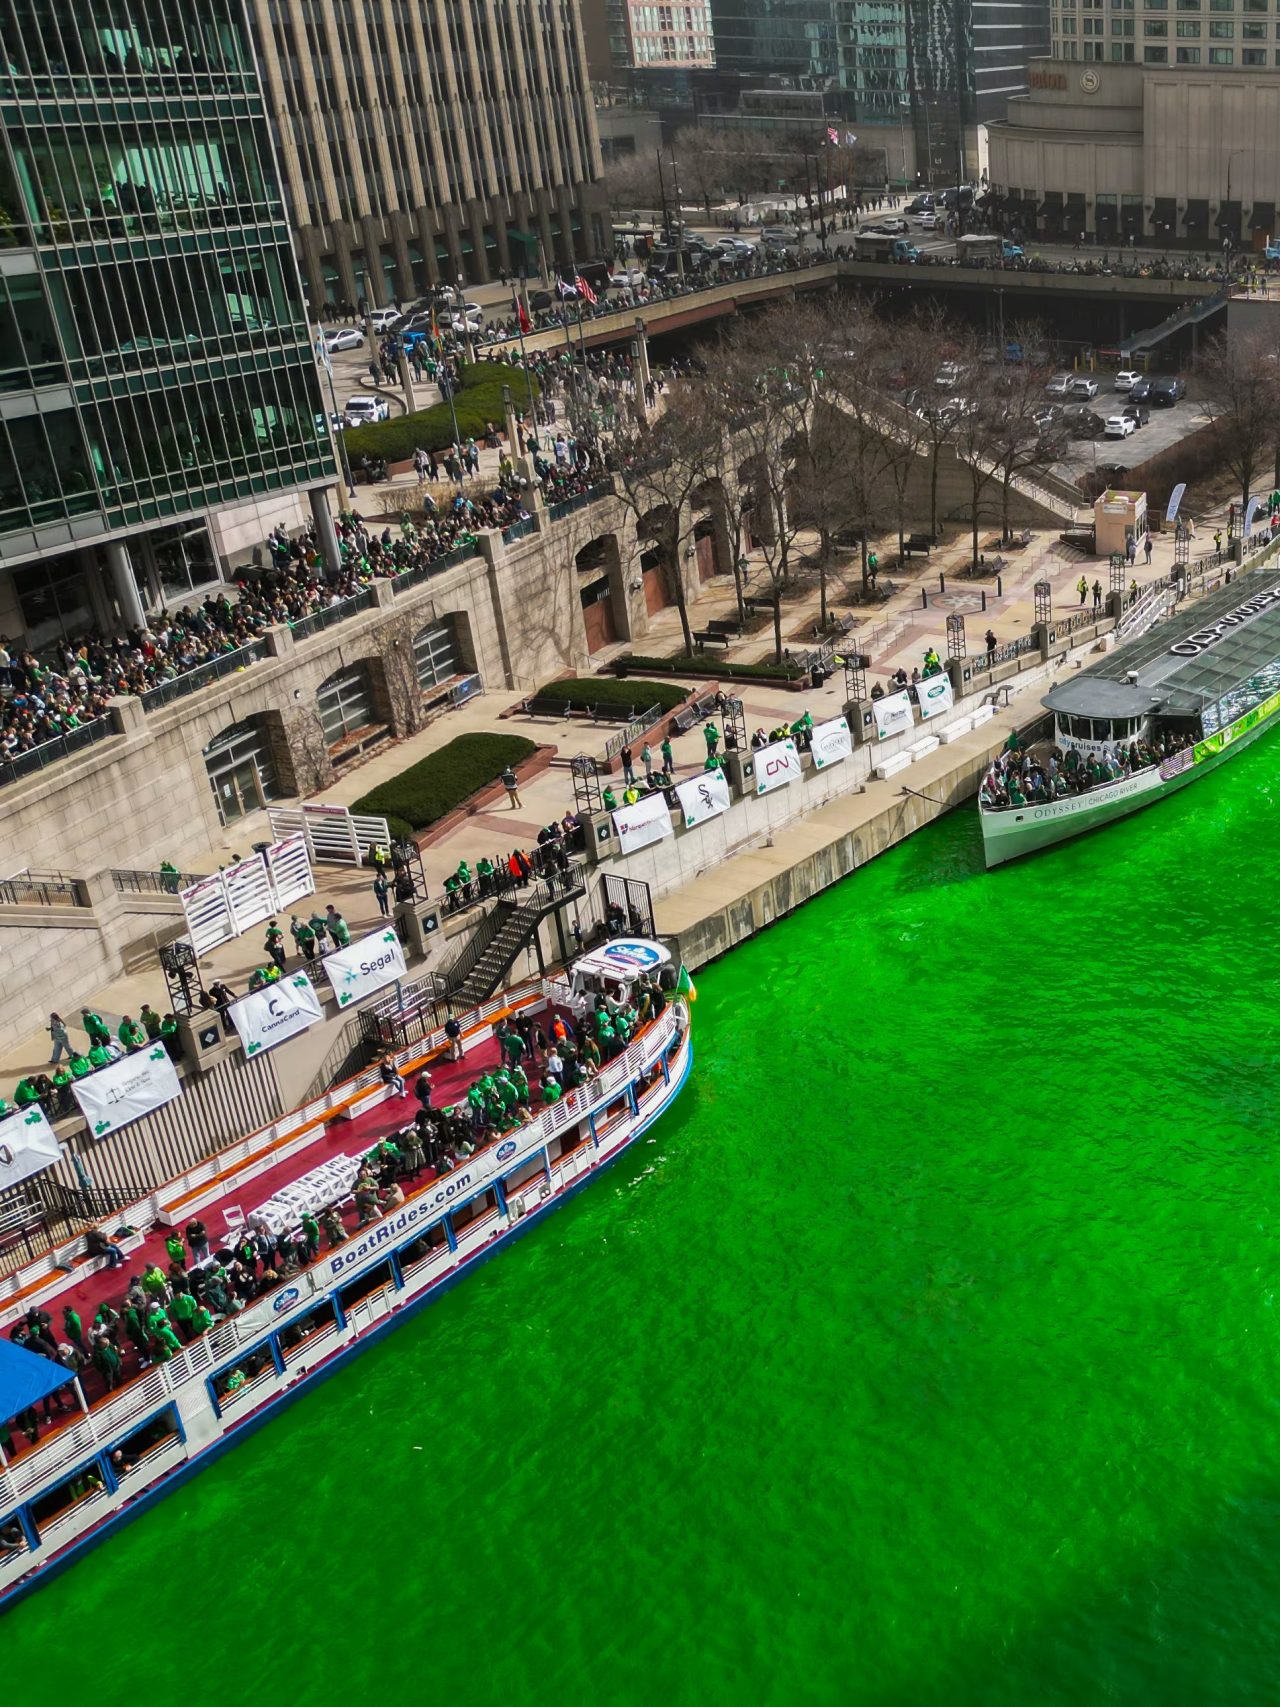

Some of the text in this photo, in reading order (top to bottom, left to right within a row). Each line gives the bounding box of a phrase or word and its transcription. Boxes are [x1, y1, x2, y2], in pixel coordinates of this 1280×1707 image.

[766, 756, 790, 776] CN
[1034, 782, 1138, 819] ODYSSEY CHICAGO RIVER
[359, 949, 396, 976] Segal
[261, 1009, 300, 1033] CannaCard
[330, 1172, 471, 1274] BoatRides.com
